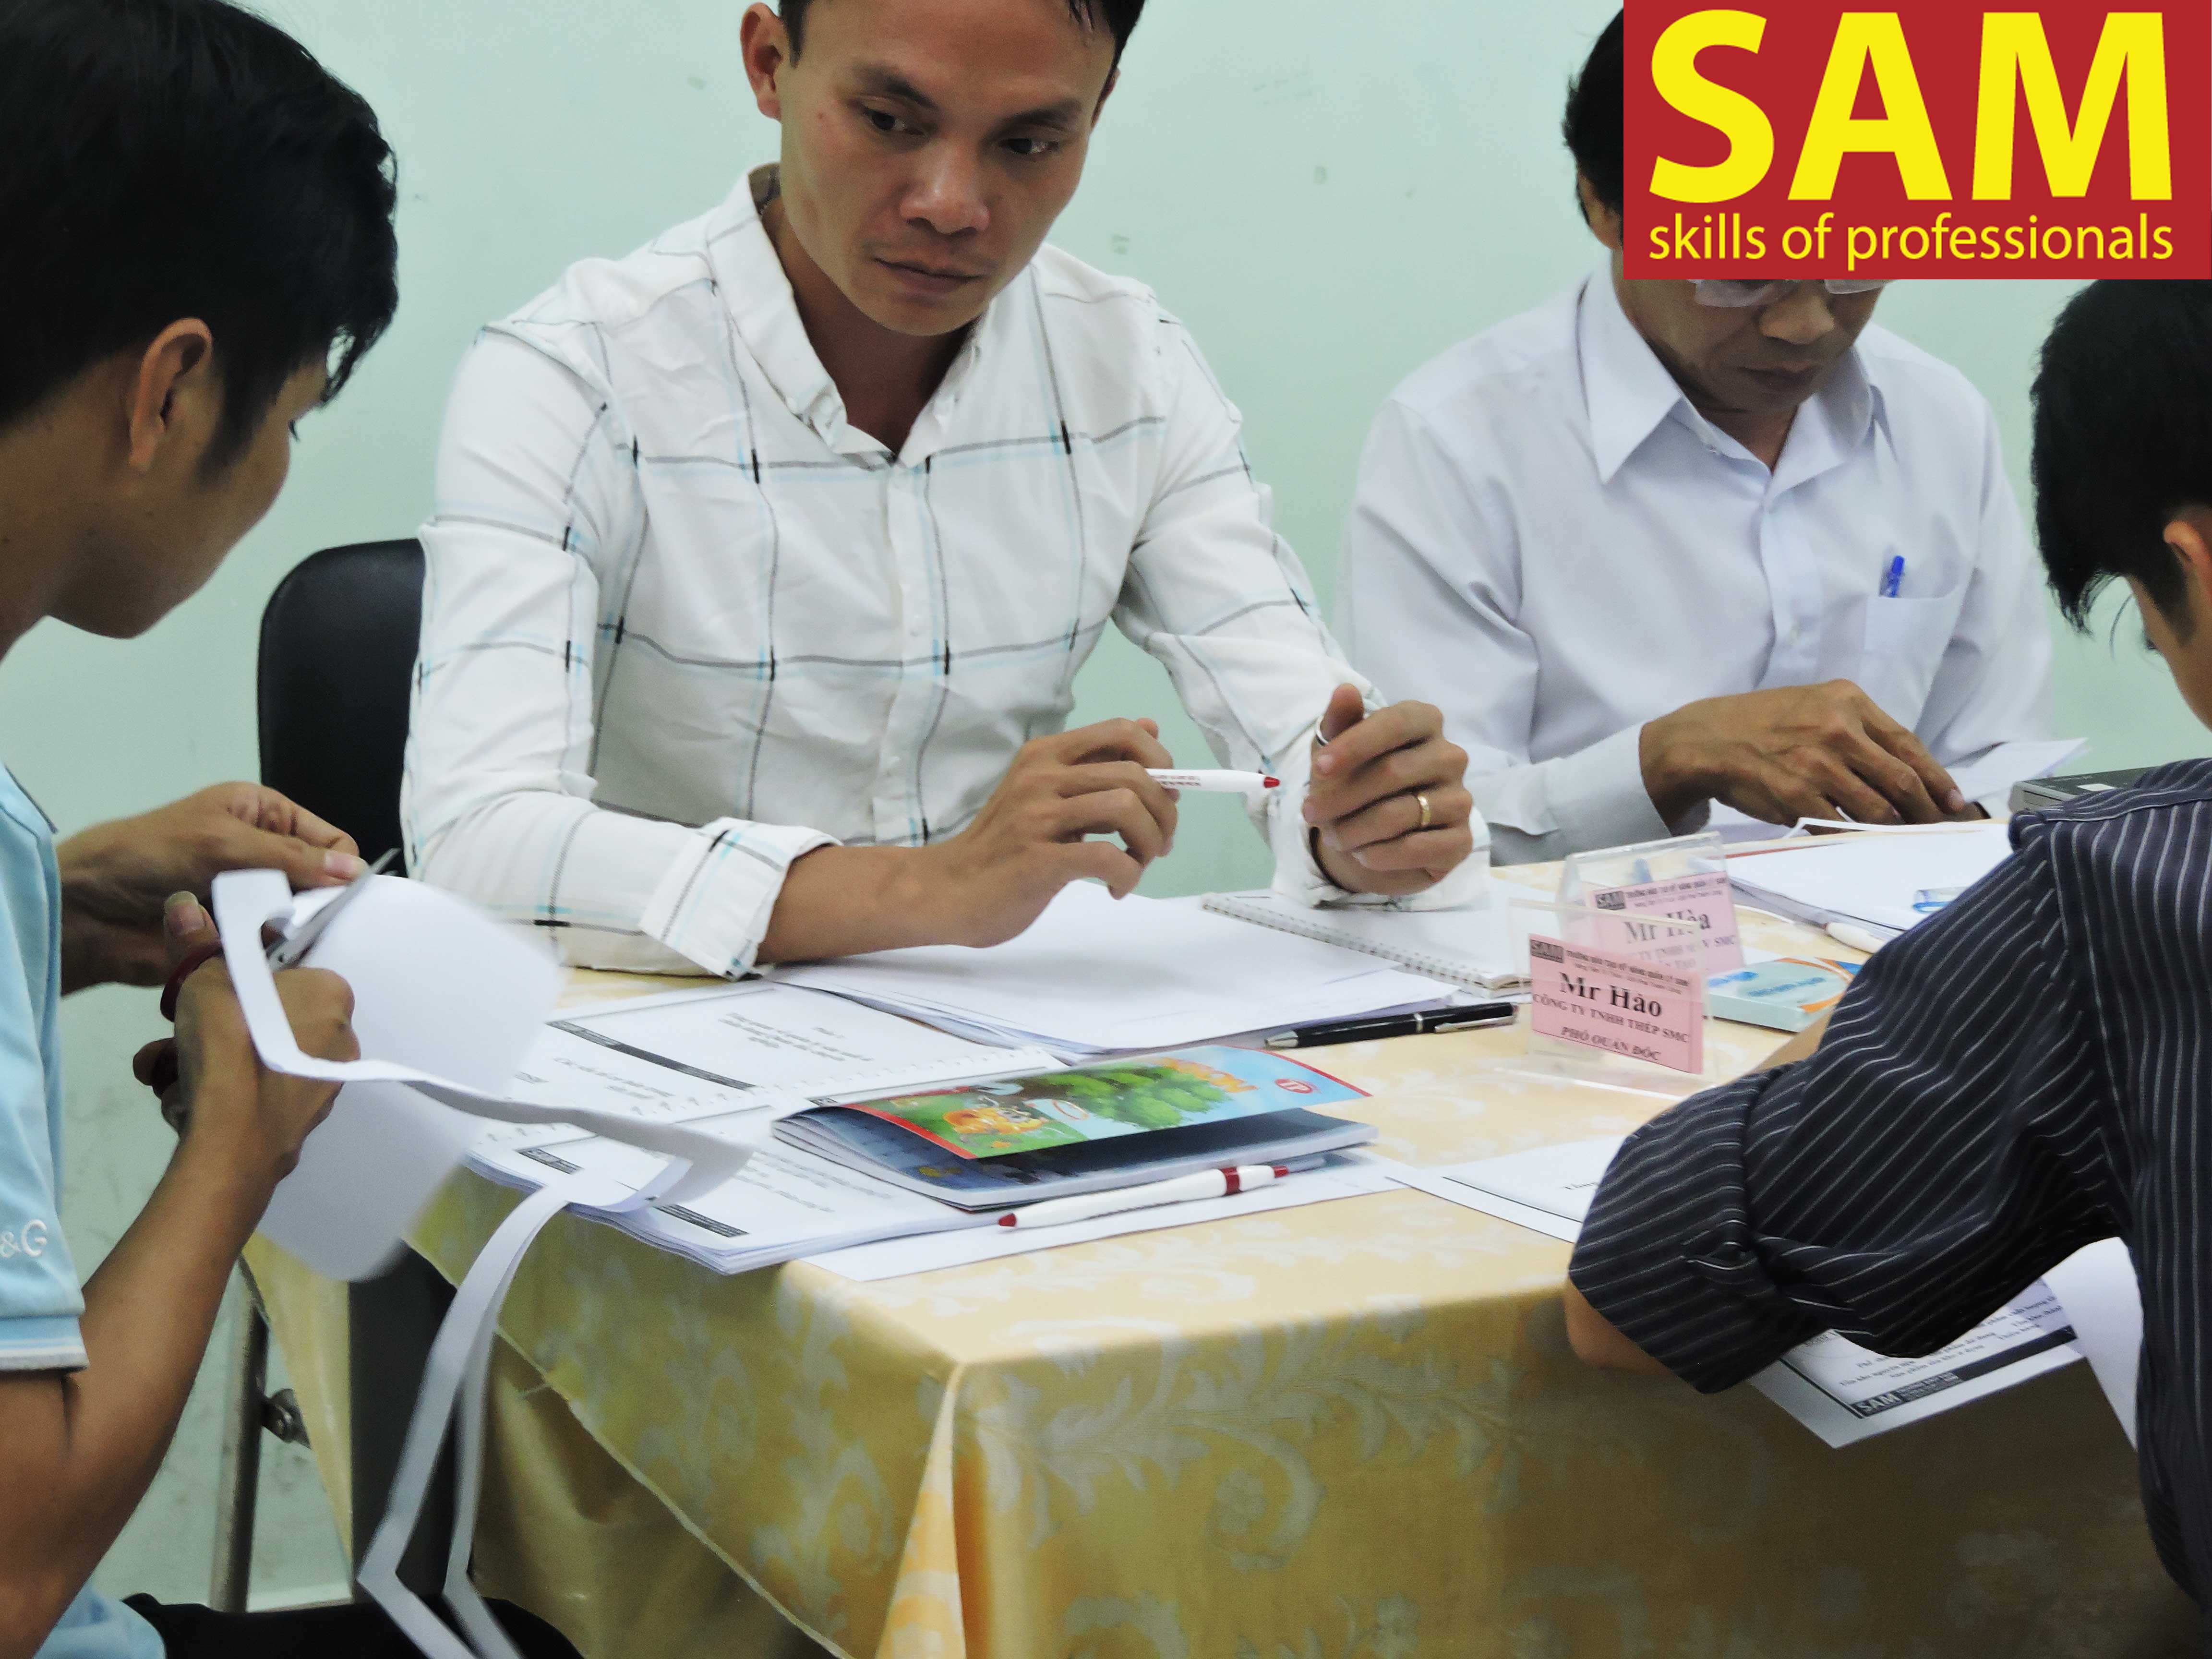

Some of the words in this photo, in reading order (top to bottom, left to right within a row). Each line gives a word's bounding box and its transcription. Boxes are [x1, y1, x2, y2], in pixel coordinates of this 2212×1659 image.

[1623, 921, 1657, 944] Mr
[1559, 972, 1601, 1000] Mr
[1533, 993, 1568, 1011] CÔNG
[1571, 1003, 1585, 1015] TY
[1590, 1009, 1625, 1026] TNHH
[1662, 1028, 1689, 1043] SMC
[1856, 1393, 1902, 1414] SAM
